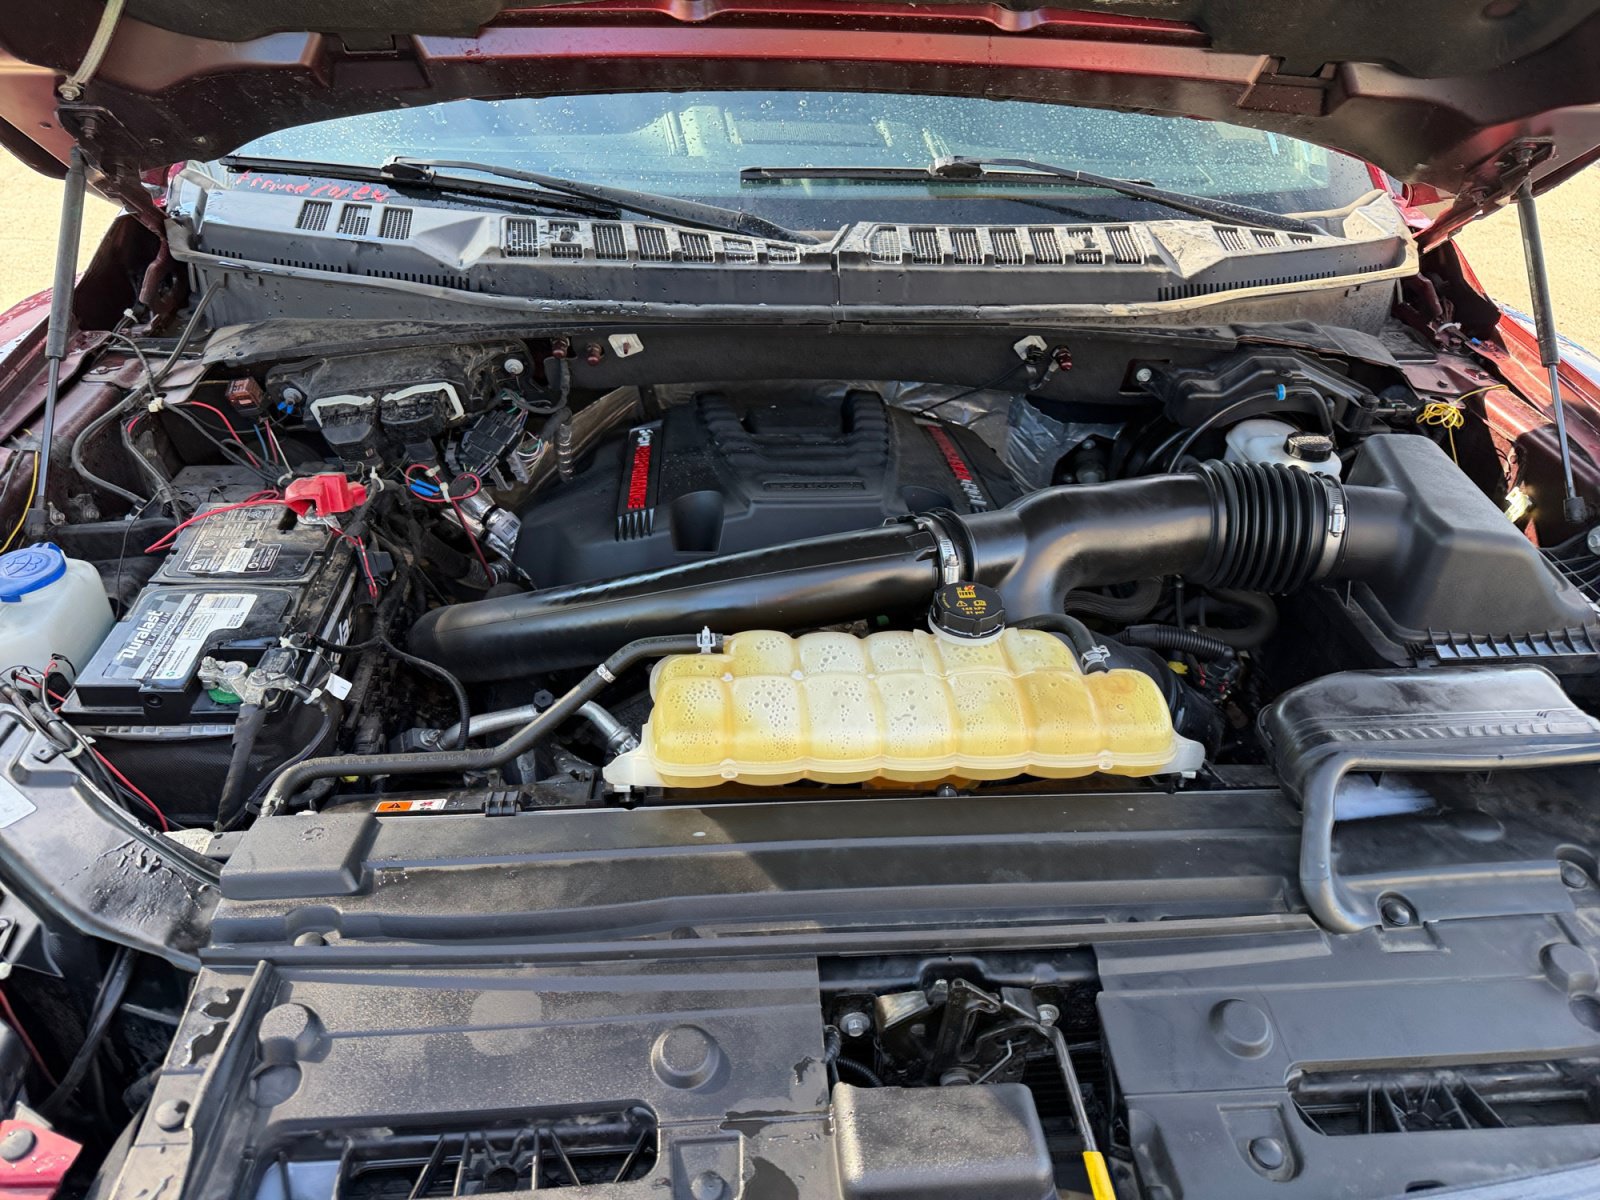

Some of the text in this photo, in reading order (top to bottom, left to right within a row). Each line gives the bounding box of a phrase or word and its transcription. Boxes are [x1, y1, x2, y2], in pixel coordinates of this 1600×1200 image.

[116, 610, 164, 660] Duralast
[145, 612, 172, 646] PLATINUM
[156, 611, 182, 650] TECHNOLOGY
